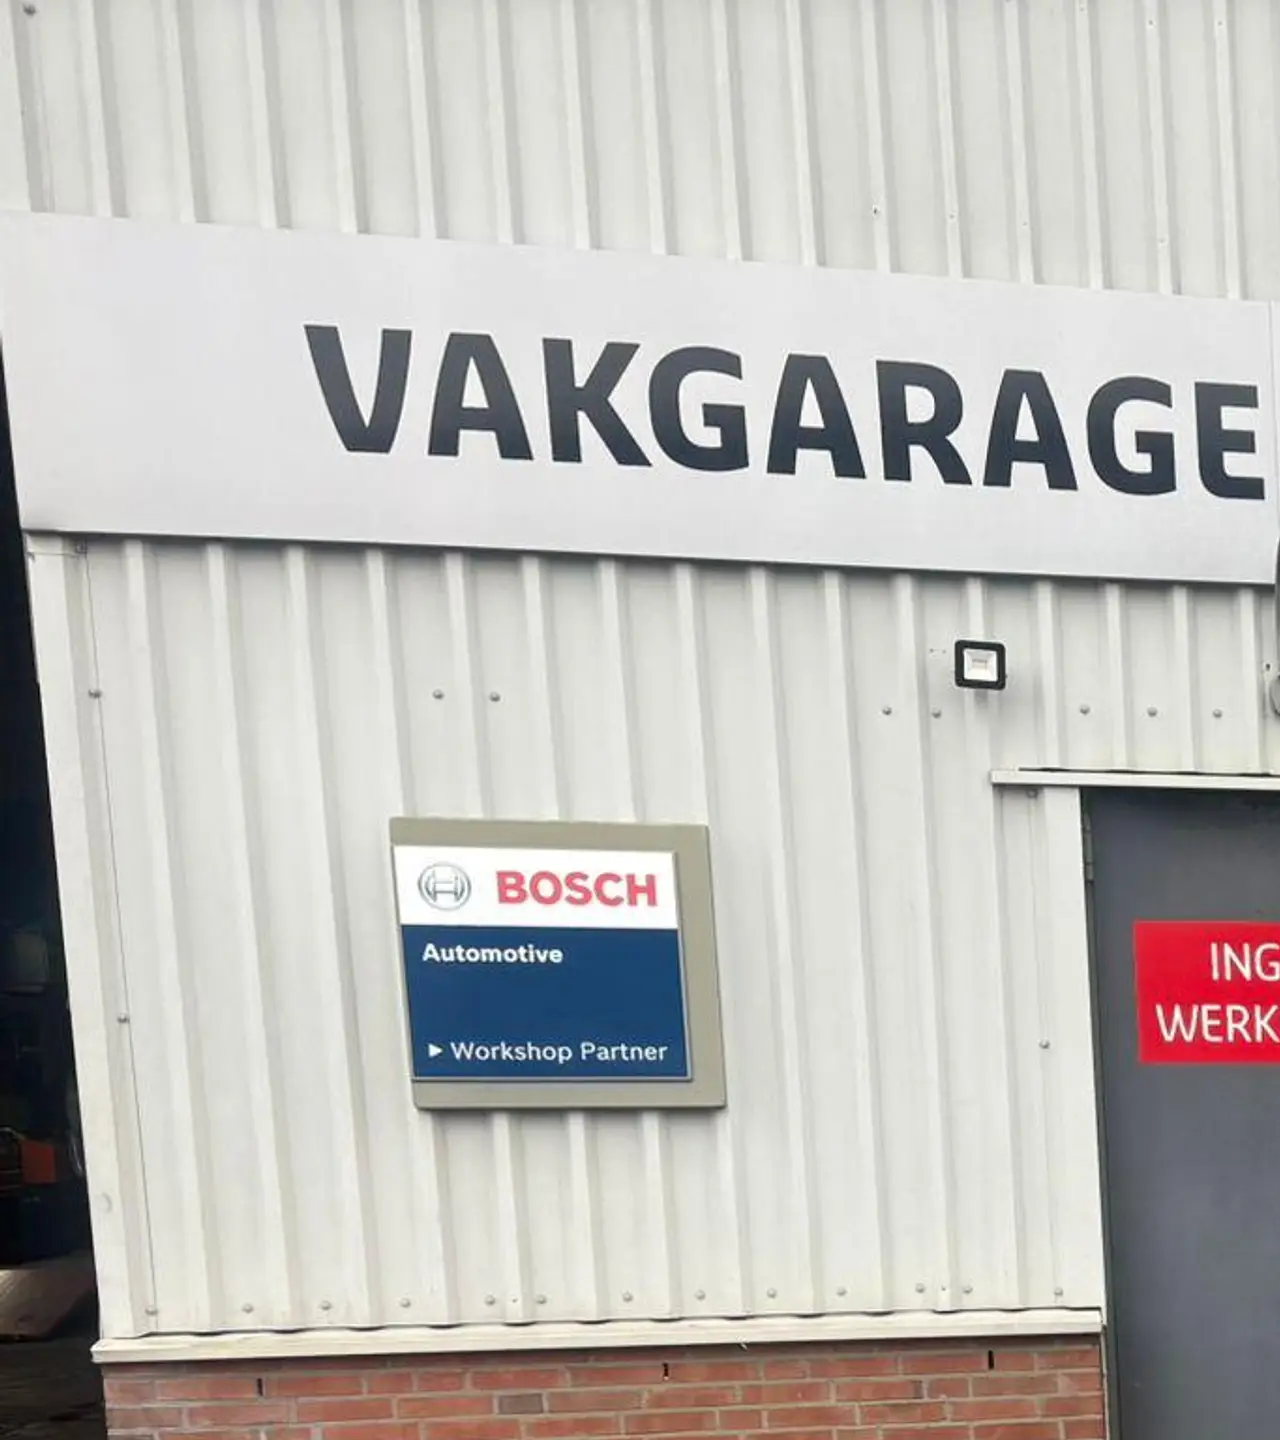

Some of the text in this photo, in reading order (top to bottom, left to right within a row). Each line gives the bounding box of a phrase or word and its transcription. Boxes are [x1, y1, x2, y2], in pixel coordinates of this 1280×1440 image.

[305, 324, 1265, 501] VAKGARAGE
[496, 871, 657, 907] BOSCH
[422, 942, 564, 964] Automotive
[450, 1041, 669, 1065] Workshop Partner
